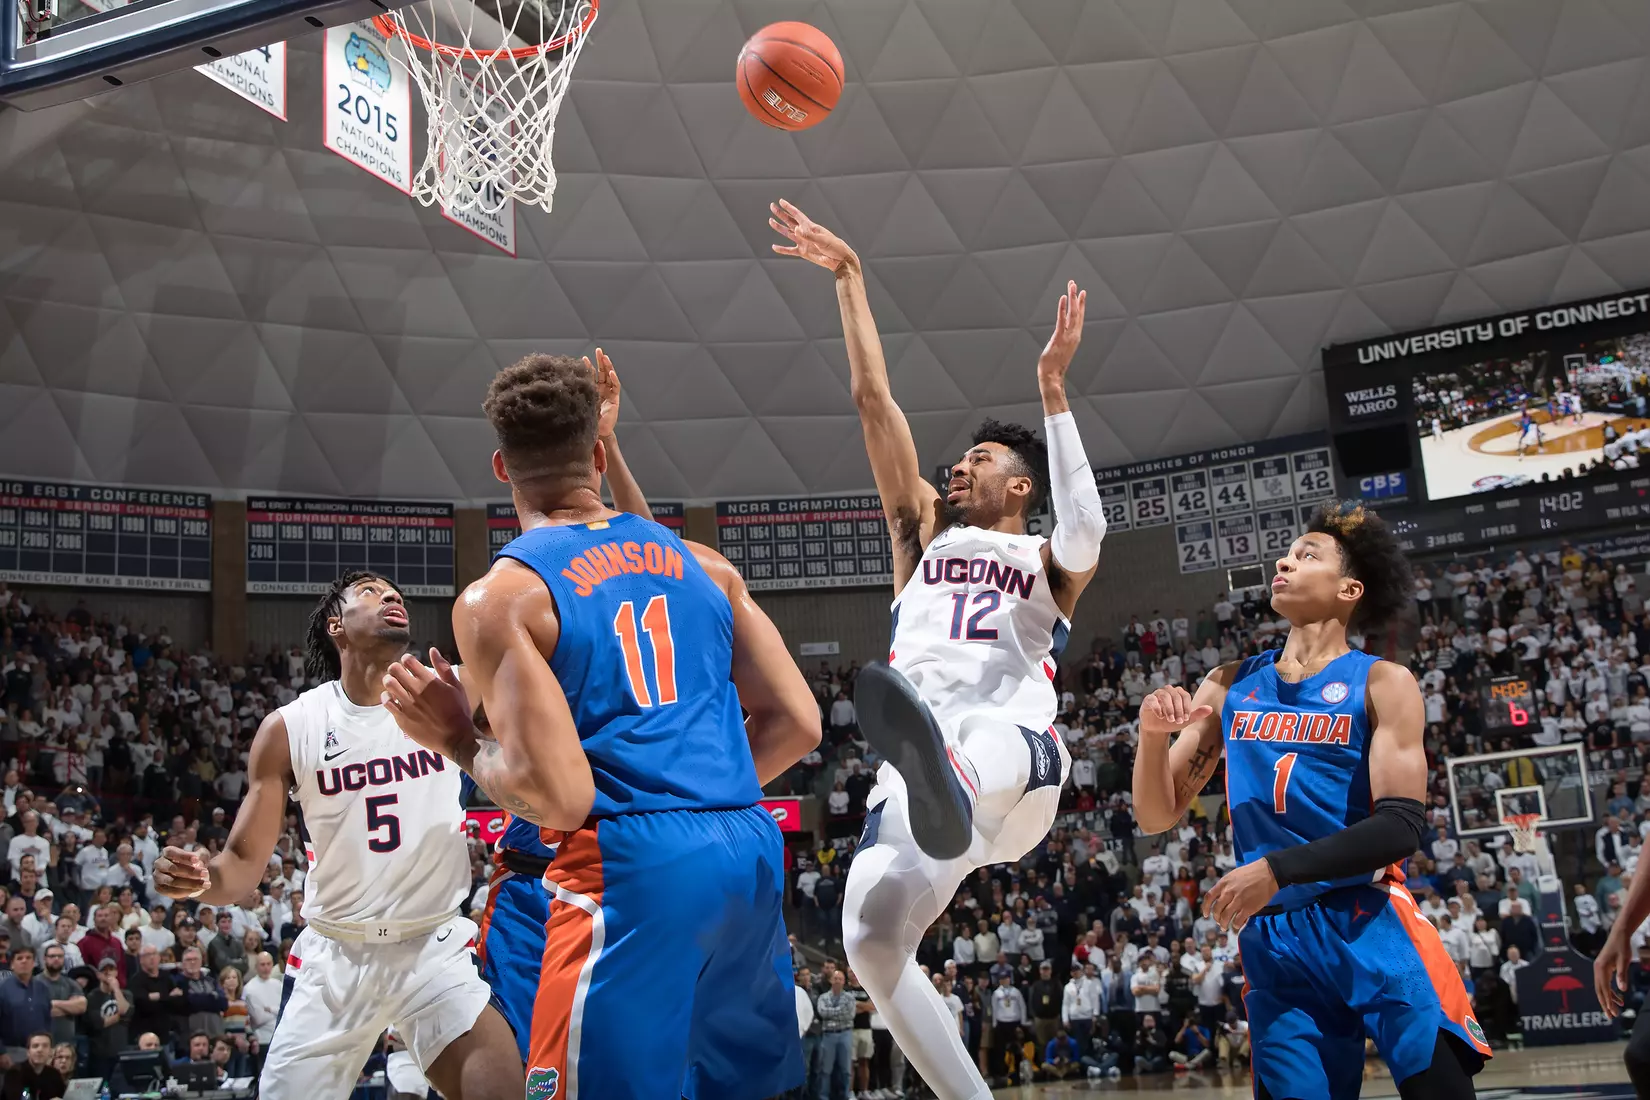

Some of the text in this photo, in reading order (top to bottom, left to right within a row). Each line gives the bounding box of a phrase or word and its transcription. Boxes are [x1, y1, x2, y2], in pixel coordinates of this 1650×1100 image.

[229, 54, 268, 84] IONAL
[206, 61, 275, 107] HAMPIONS
[338, 84, 397, 142] 2015
[341, 119, 397, 163] NATIONAL
[336, 136, 402, 183] CHAMPIONS
[453, 165, 506, 211] 016
[456, 193, 503, 228] NATIONAL
[452, 205, 508, 247] CHAMPIONS
[1357, 294, 1650, 365] UNIVERSITY OF CONNECT
[1344, 385, 1397, 403] WELLS
[1348, 398, 1398, 416] FARGO
[1096, 446, 1255, 480] ONN HUSKIES OF HONOR
[1301, 471, 1330, 491] 42
[1360, 472, 1402, 491] CBS
[33, 484, 81, 498] EAST
[90, 488, 206, 507] CONFERENCE
[1178, 491, 1206, 511] 42
[1218, 484, 1246, 504] 44
[1539, 491, 1583, 514] 14:02
[0, 497, 206, 518] EGULAR SEASON CHAMPIONS
[252, 501, 267, 510] BIG
[268, 502, 292, 510] EAST
[304, 503, 350, 512] AMERICAN
[351, 504, 393, 513] ATHLETIC
[394, 506, 449, 516] CONFERENCE
[728, 498, 881, 514] NCAA CHAMPIONSH
[1137, 498, 1165, 519] 25
[58, 513, 81, 528] 1995
[267, 514, 436, 526] TOURNAMENT CHAMPIONS
[728, 510, 885, 525] TOURNAMENT APPEARANC
[370, 528, 393, 542] 2002
[399, 529, 422, 543] 2004
[428, 530, 450, 544] 2011
[491, 529, 513, 544] 1955
[723, 527, 742, 541] 1951
[749, 526, 770, 540] 1954
[804, 523, 824, 537] 1957
[1266, 529, 1292, 550] 22
[250, 545, 273, 559] 2016
[1184, 542, 1212, 563] 24
[1226, 536, 1249, 556] 13
[560, 541, 684, 597] JOHNSON
[779, 562, 800, 576] 1994
[806, 561, 827, 575] 1995
[923, 557, 1036, 600] UCONN
[0, 571, 79, 584] ONNECTICUT
[128, 578, 204, 590] BASKETBALL
[253, 584, 330, 593] CONNECTICU
[747, 579, 800, 589] NECTICUT
[841, 575, 894, 585] BASKETBA
[401, 587, 449, 596] KETBALL
[949, 590, 1001, 640] 12
[613, 594, 678, 708] 11
[1491, 681, 1528, 699] 14:02
[1508, 701, 1529, 726] 6
[1229, 711, 1352, 745] FLORIDA
[316, 749, 445, 796] UCONN
[1274, 752, 1298, 813] 1
[365, 793, 402, 853] 5
[1520, 1011, 1613, 1031] TRAVELERS
